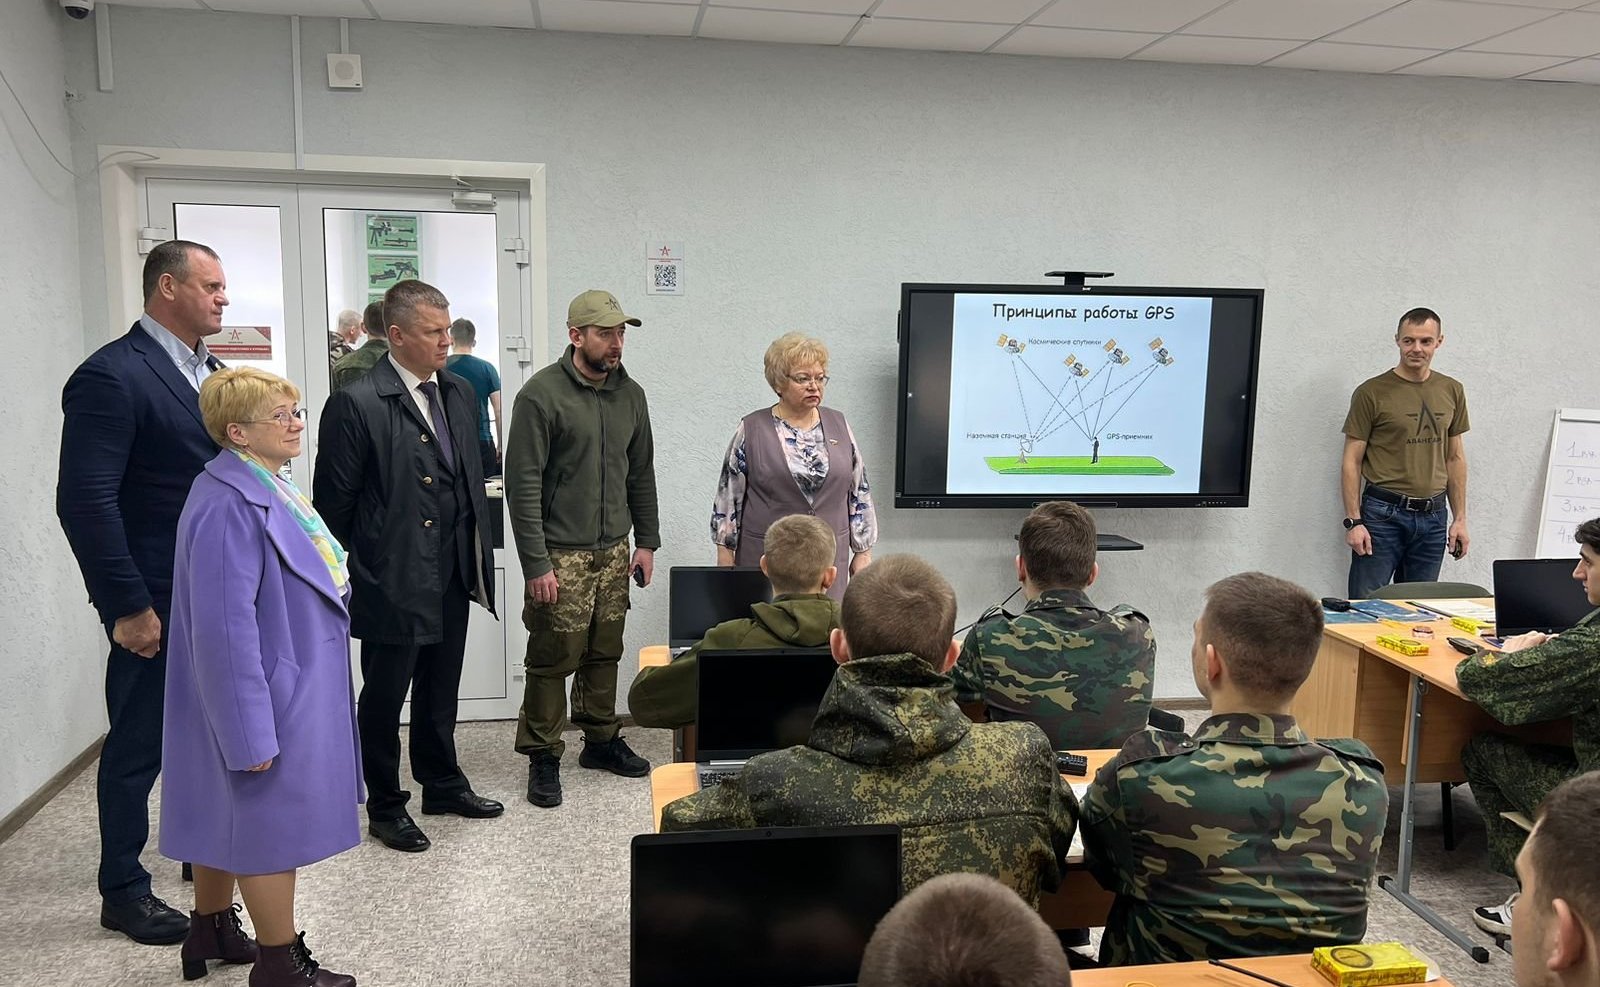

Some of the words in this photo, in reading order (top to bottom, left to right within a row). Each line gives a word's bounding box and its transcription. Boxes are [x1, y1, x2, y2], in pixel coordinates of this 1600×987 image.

[993, 303, 1077, 321] Принципы
[1084, 305, 1139, 322] работы
[1145, 305, 1175, 320] GPS
